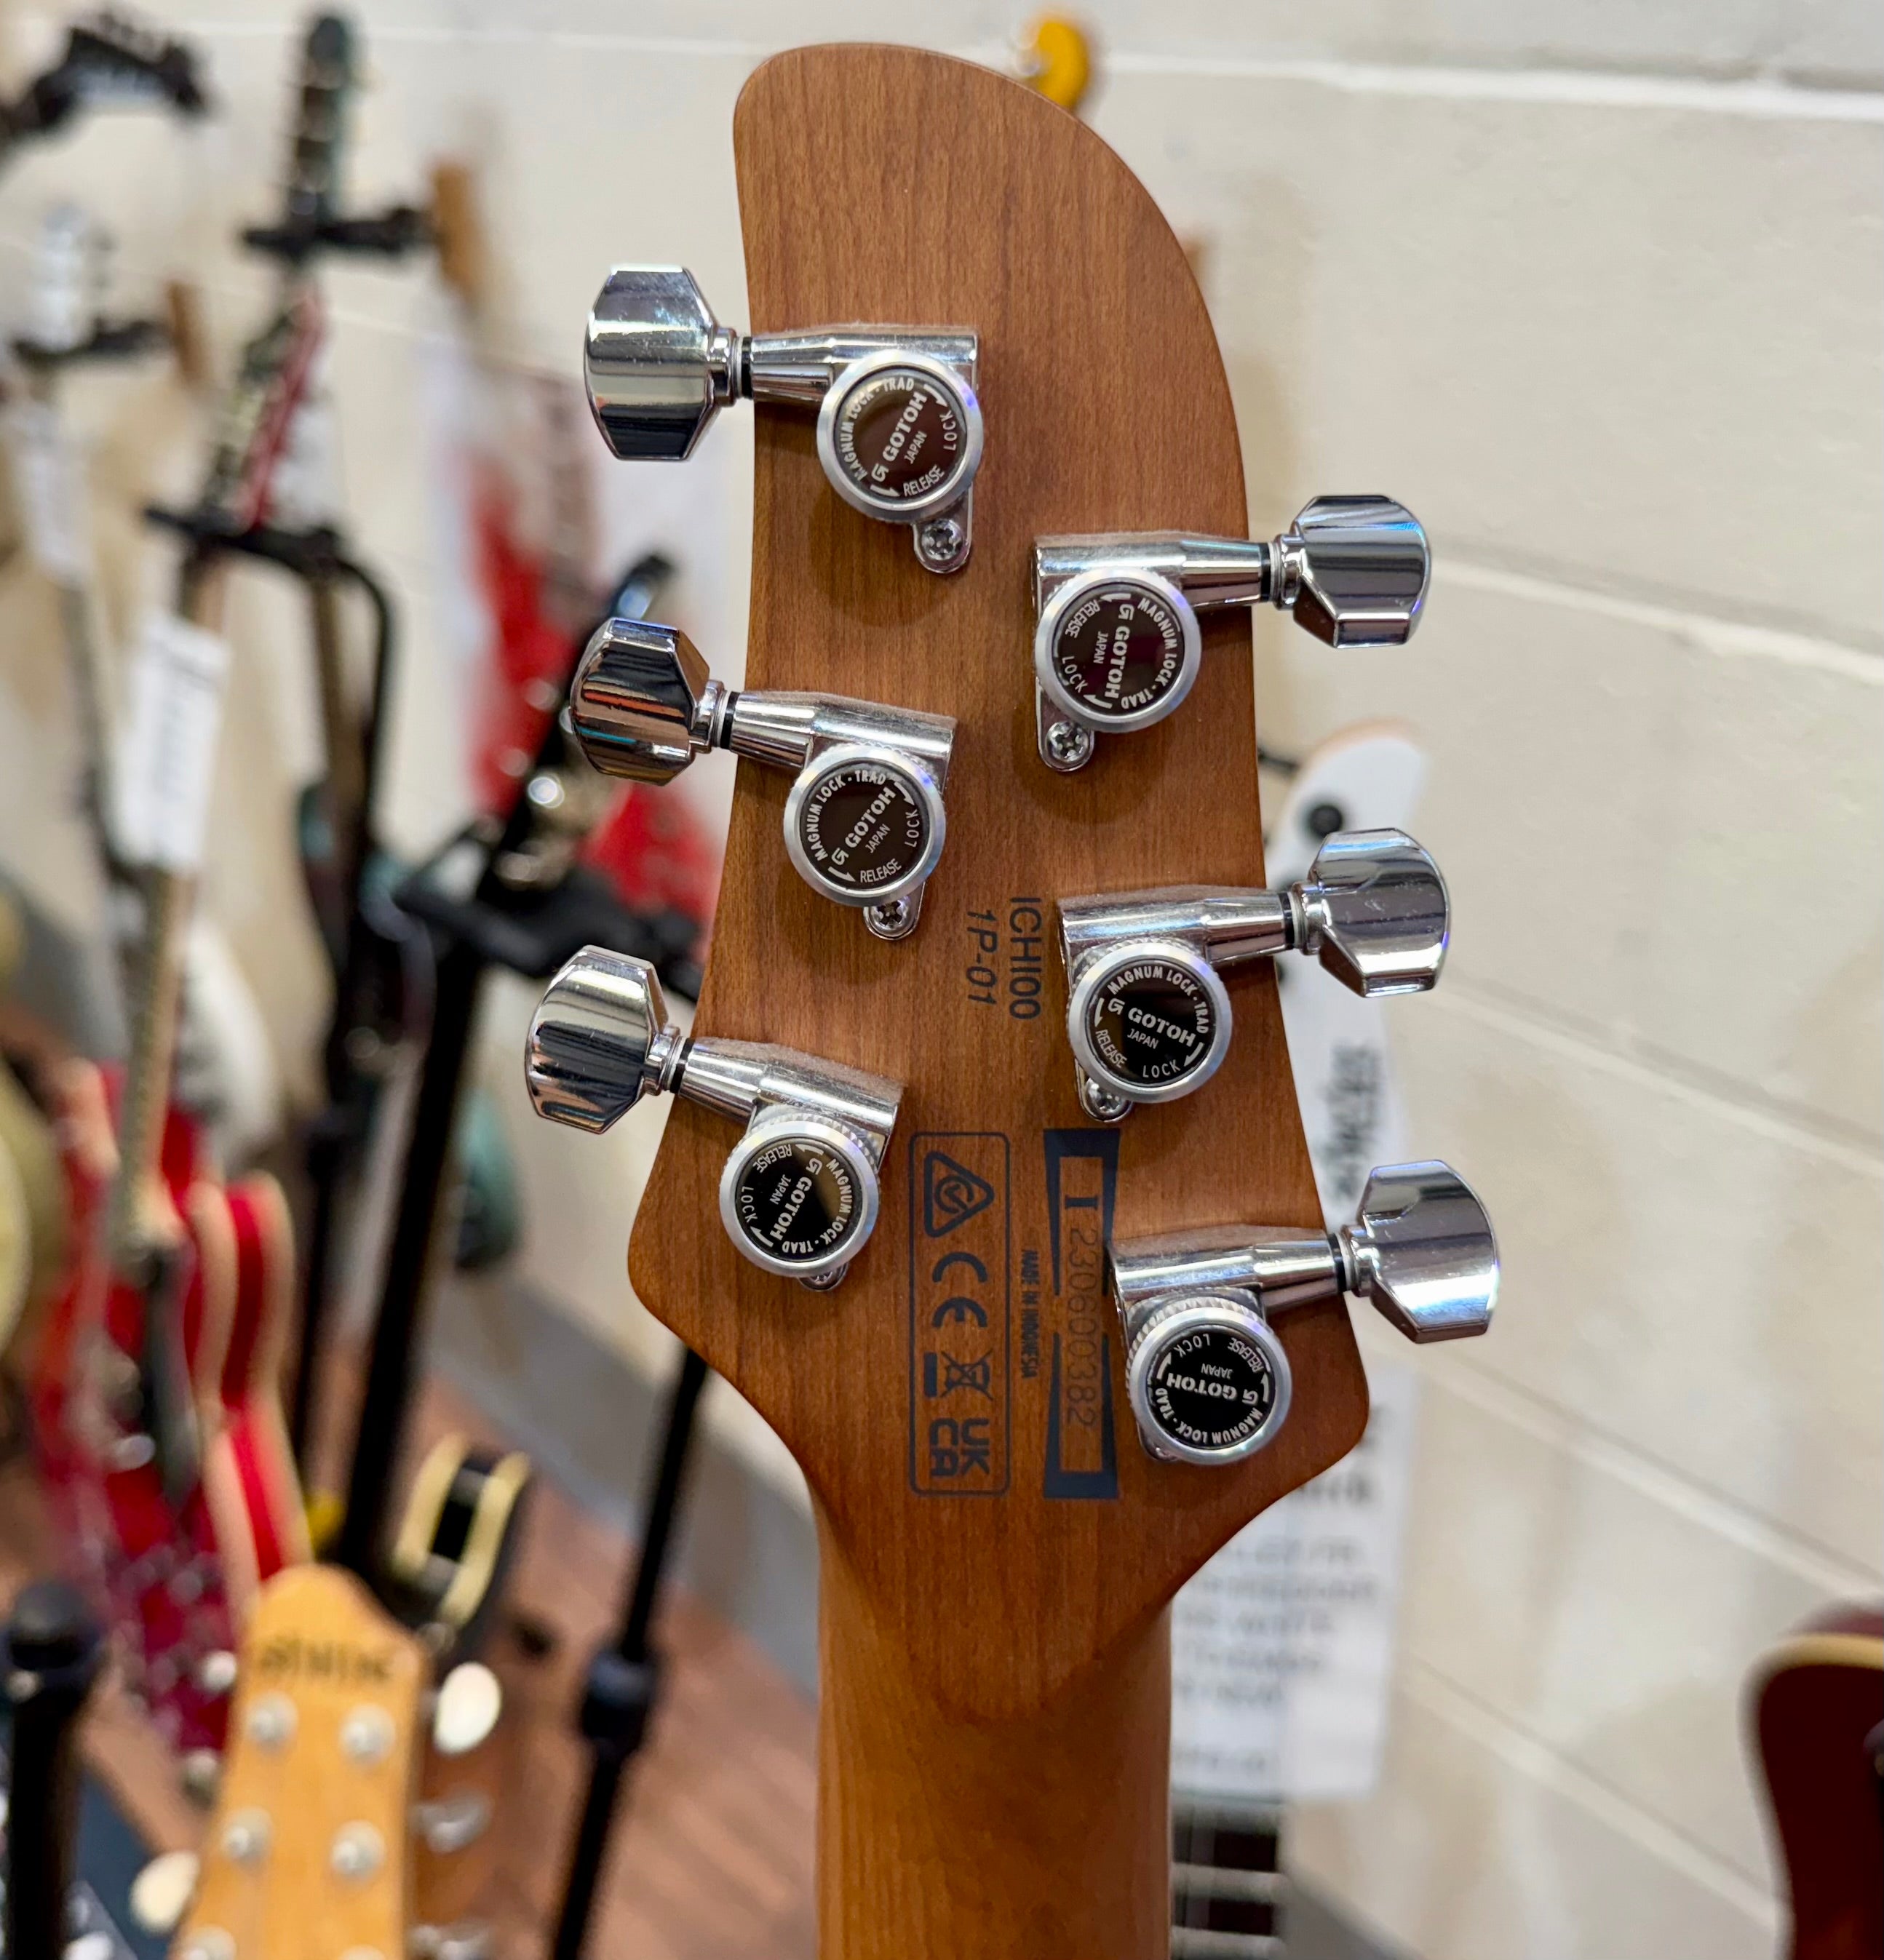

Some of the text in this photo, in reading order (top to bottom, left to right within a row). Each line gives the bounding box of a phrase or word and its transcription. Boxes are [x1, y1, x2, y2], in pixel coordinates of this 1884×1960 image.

[840, 377, 915, 481] MAGNUM LOCK TRAD
[882, 391, 927, 462] GOTOH
[939, 410, 957, 451] LOCK
[904, 431, 927, 464] JAPAN
[903, 465, 945, 497] RELEASE
[1065, 599, 1101, 638] RELEASE
[1093, 631, 1108, 664] JAPAN
[1105, 625, 1131, 699] GOTOH
[1121, 597, 1178, 709] MAGNUM LOCK TRAD
[1062, 656, 1088, 693] LOCK
[806, 770, 886, 861] MAGNUM LOCK TRAD
[845, 786, 897, 848] GOTOH
[905, 809, 920, 848] LOCK
[865, 824, 891, 853] JAPAN
[859, 859, 902, 883] RELEASE
[966, 910, 998, 1005] 1P-01
[1107, 965, 1209, 1034] MAGNUM LOCK TRAD
[1127, 1028, 1159, 1049] JAPAN
[1128, 1007, 1196, 1047] GOTOH
[1095, 1029, 1127, 1069] RELEASE
[1142, 1059, 1181, 1078] LOCK
[752, 1144, 792, 1174] RELEASE
[741, 1186, 758, 1223] LOCK
[769, 1174, 792, 1206] JAPAN
[769, 1176, 813, 1240] GOTOH
[782, 1158, 853, 1254] MAGNUM LOCK TRAD
[1021, 1249, 1040, 1378] MADE IN INDONESIA
[1068, 1227, 1098, 1427] 230600382
[1174, 1334, 1211, 1358] LOCK
[1228, 1337, 1265, 1373] RELEASE
[1166, 1372, 1237, 1401] GOTOH
[1201, 1363, 1233, 1379] JAPAN
[1155, 1387, 1263, 1444] MAGNUM LOCK TRAD
[930, 1419, 958, 1476] CA
[961, 1419, 990, 1475] UK
